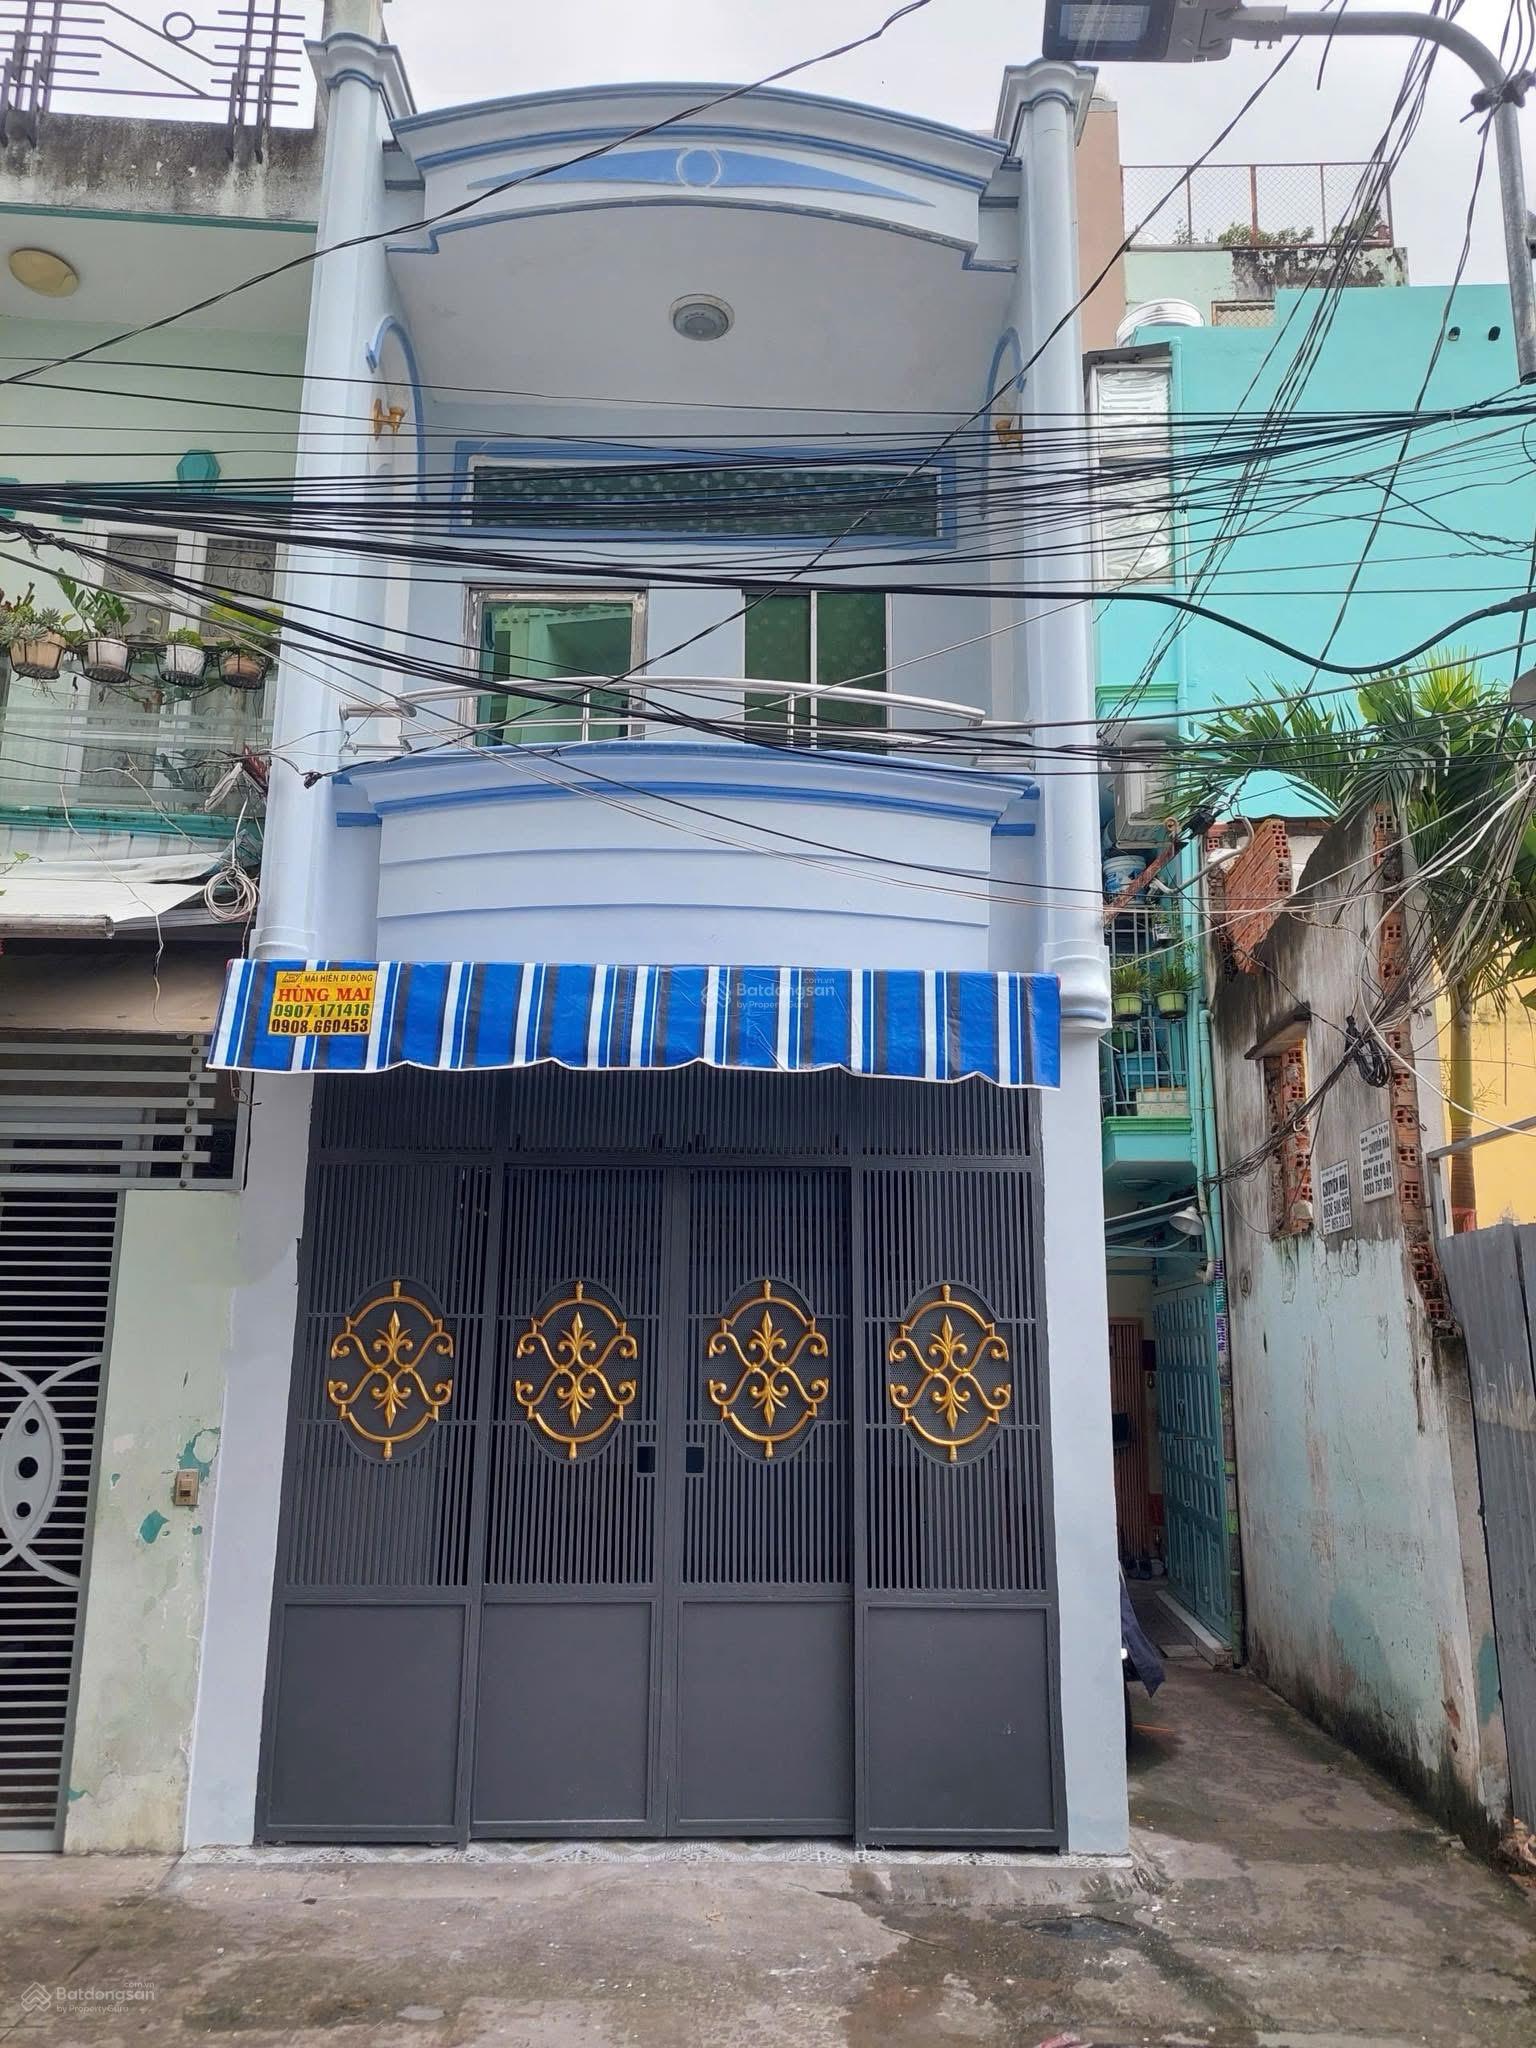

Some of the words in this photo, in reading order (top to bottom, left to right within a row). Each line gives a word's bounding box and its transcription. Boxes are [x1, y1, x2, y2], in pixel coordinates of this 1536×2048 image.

[350, 973, 373, 983] ĐỘNG
[278, 984, 330, 1003] HÙNG
[336, 987, 372, 1002] MAI
[274, 1003, 370, 1018] 0907.171416
[271, 1019, 369, 1034] 0908.660453
